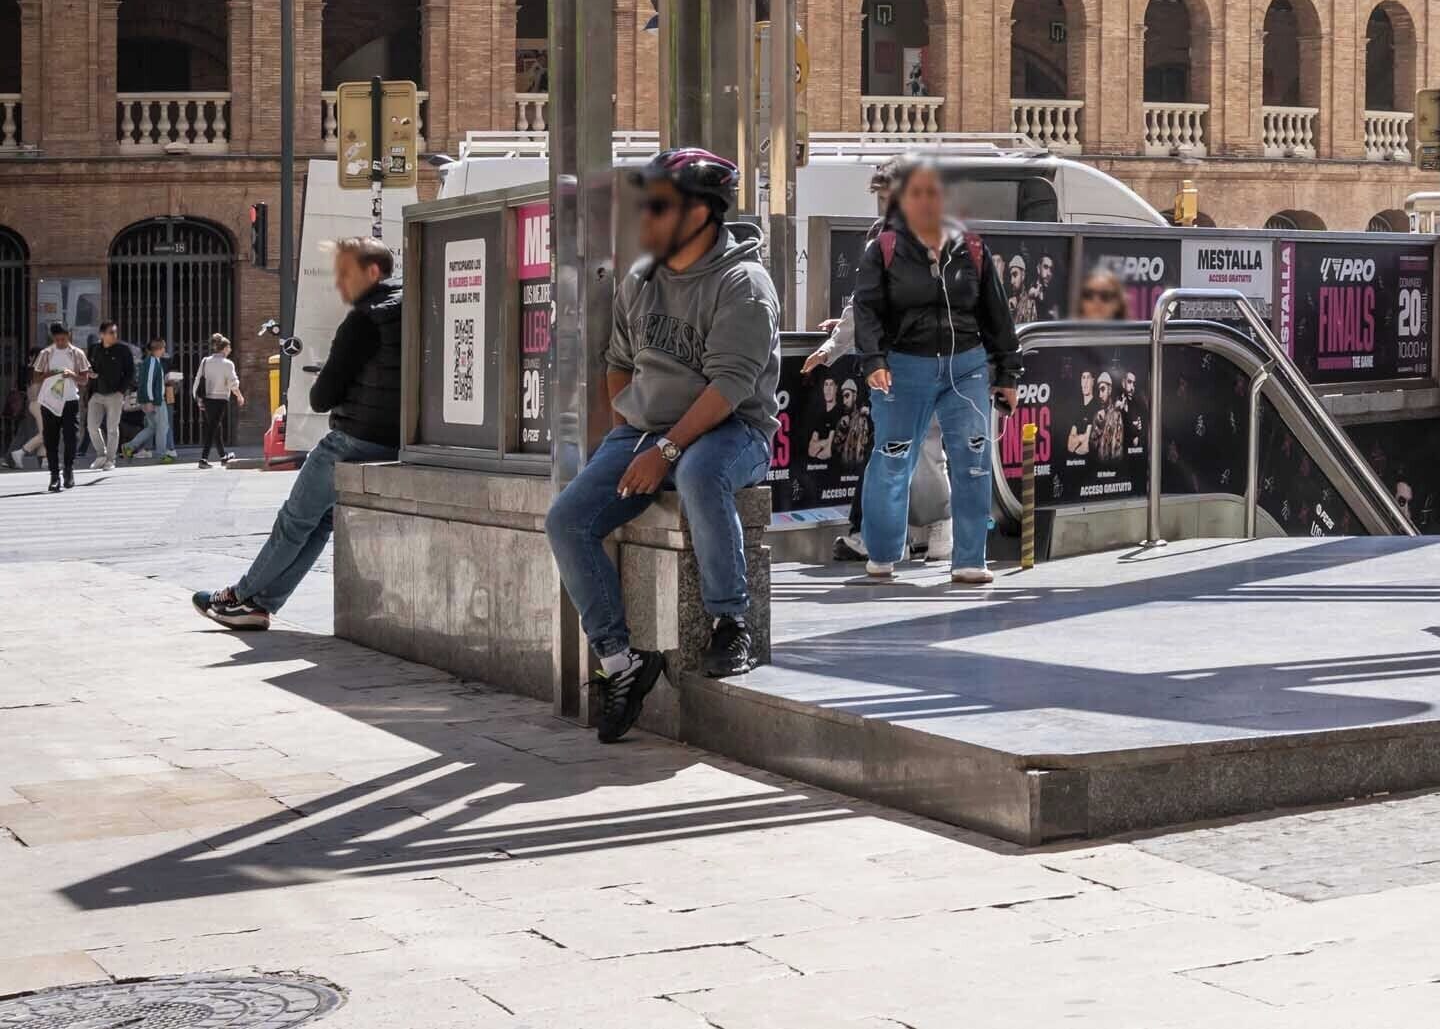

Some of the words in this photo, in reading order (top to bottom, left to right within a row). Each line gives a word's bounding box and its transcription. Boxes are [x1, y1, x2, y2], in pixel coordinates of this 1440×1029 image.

[1197, 249, 1263, 270] MESTALLA
[1209, 274, 1228, 282] ACCESO
[1228, 274, 1252, 282] GRATUITO
[1318, 286, 1375, 353] FINALS
[1398, 288, 1421, 337] 20
[523, 370, 540, 419] 20
[1080, 484, 1104, 496] ACCESO
[1104, 481, 1132, 493] GRATUITO
